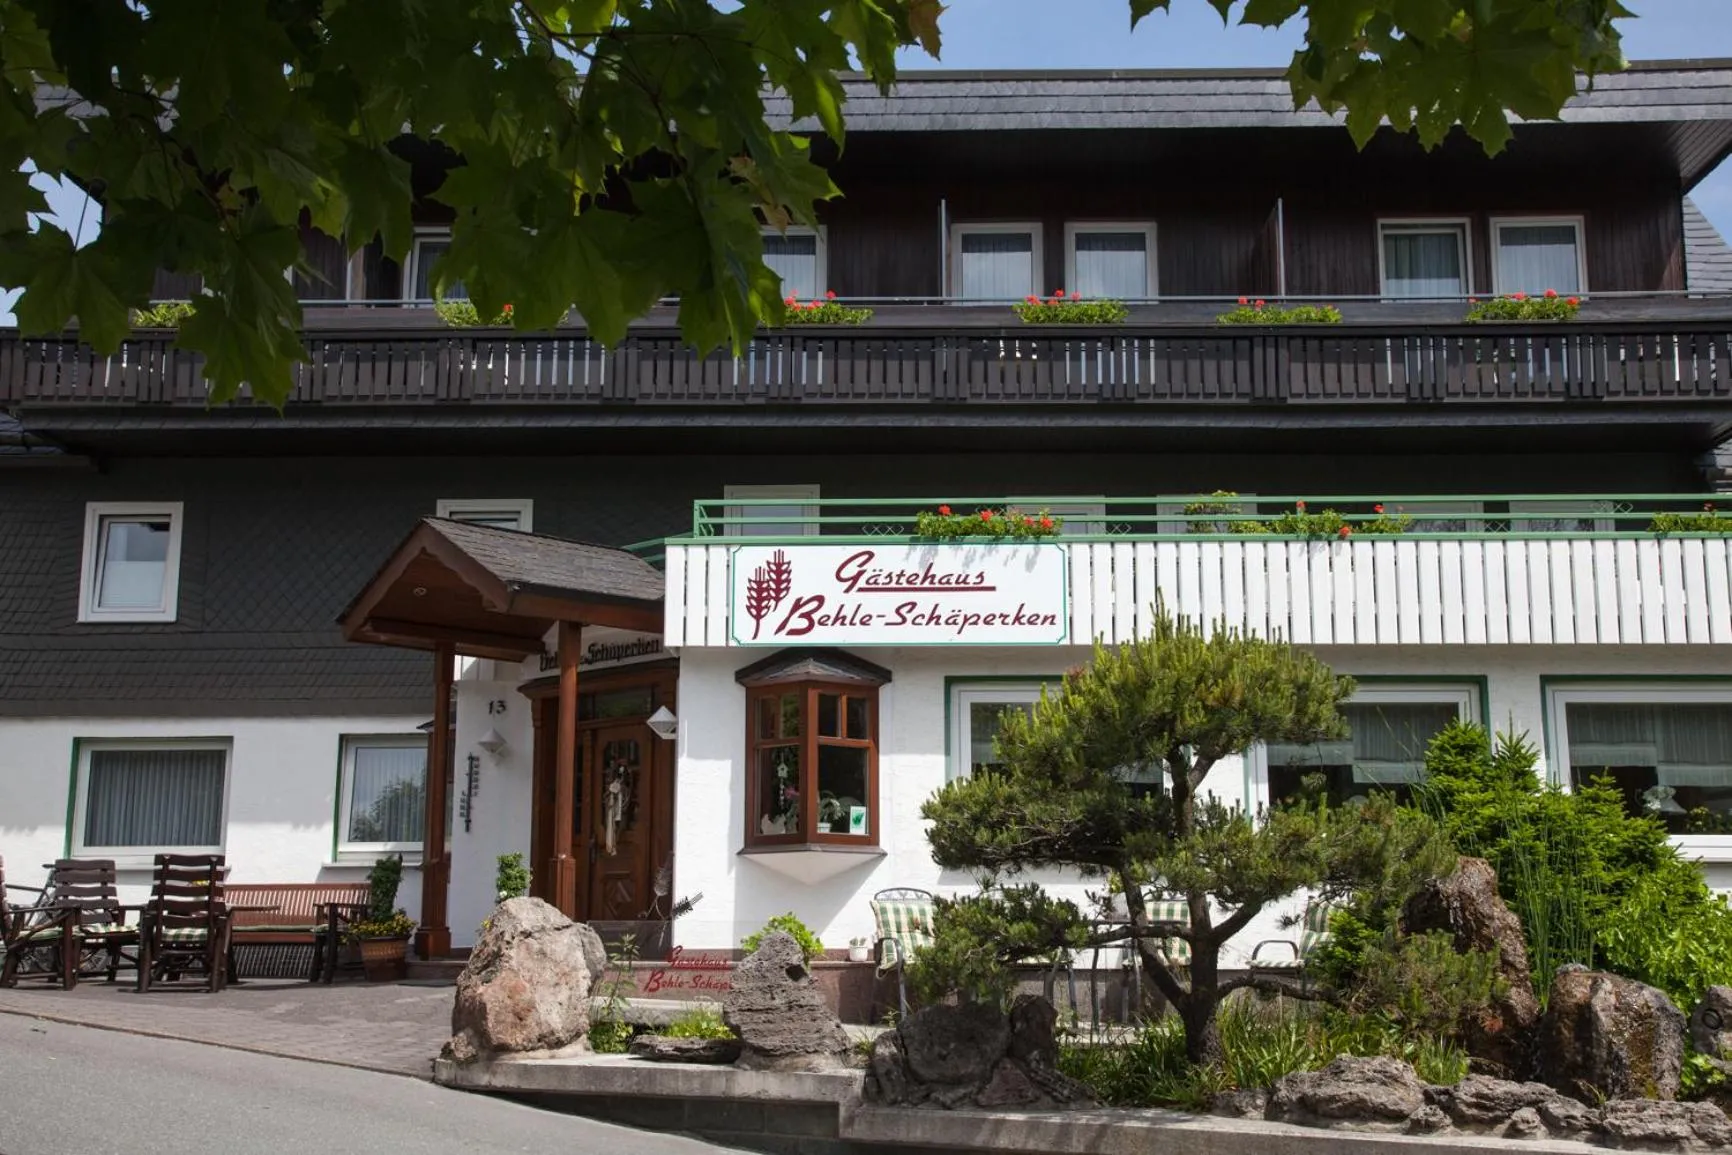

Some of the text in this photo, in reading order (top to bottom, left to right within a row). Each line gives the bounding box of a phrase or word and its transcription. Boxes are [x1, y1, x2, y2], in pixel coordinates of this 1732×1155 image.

[835, 550, 986, 593] Gästehaus
[774, 594, 1057, 636] Behle-Schäperken
[488, 700, 507, 715] 13
